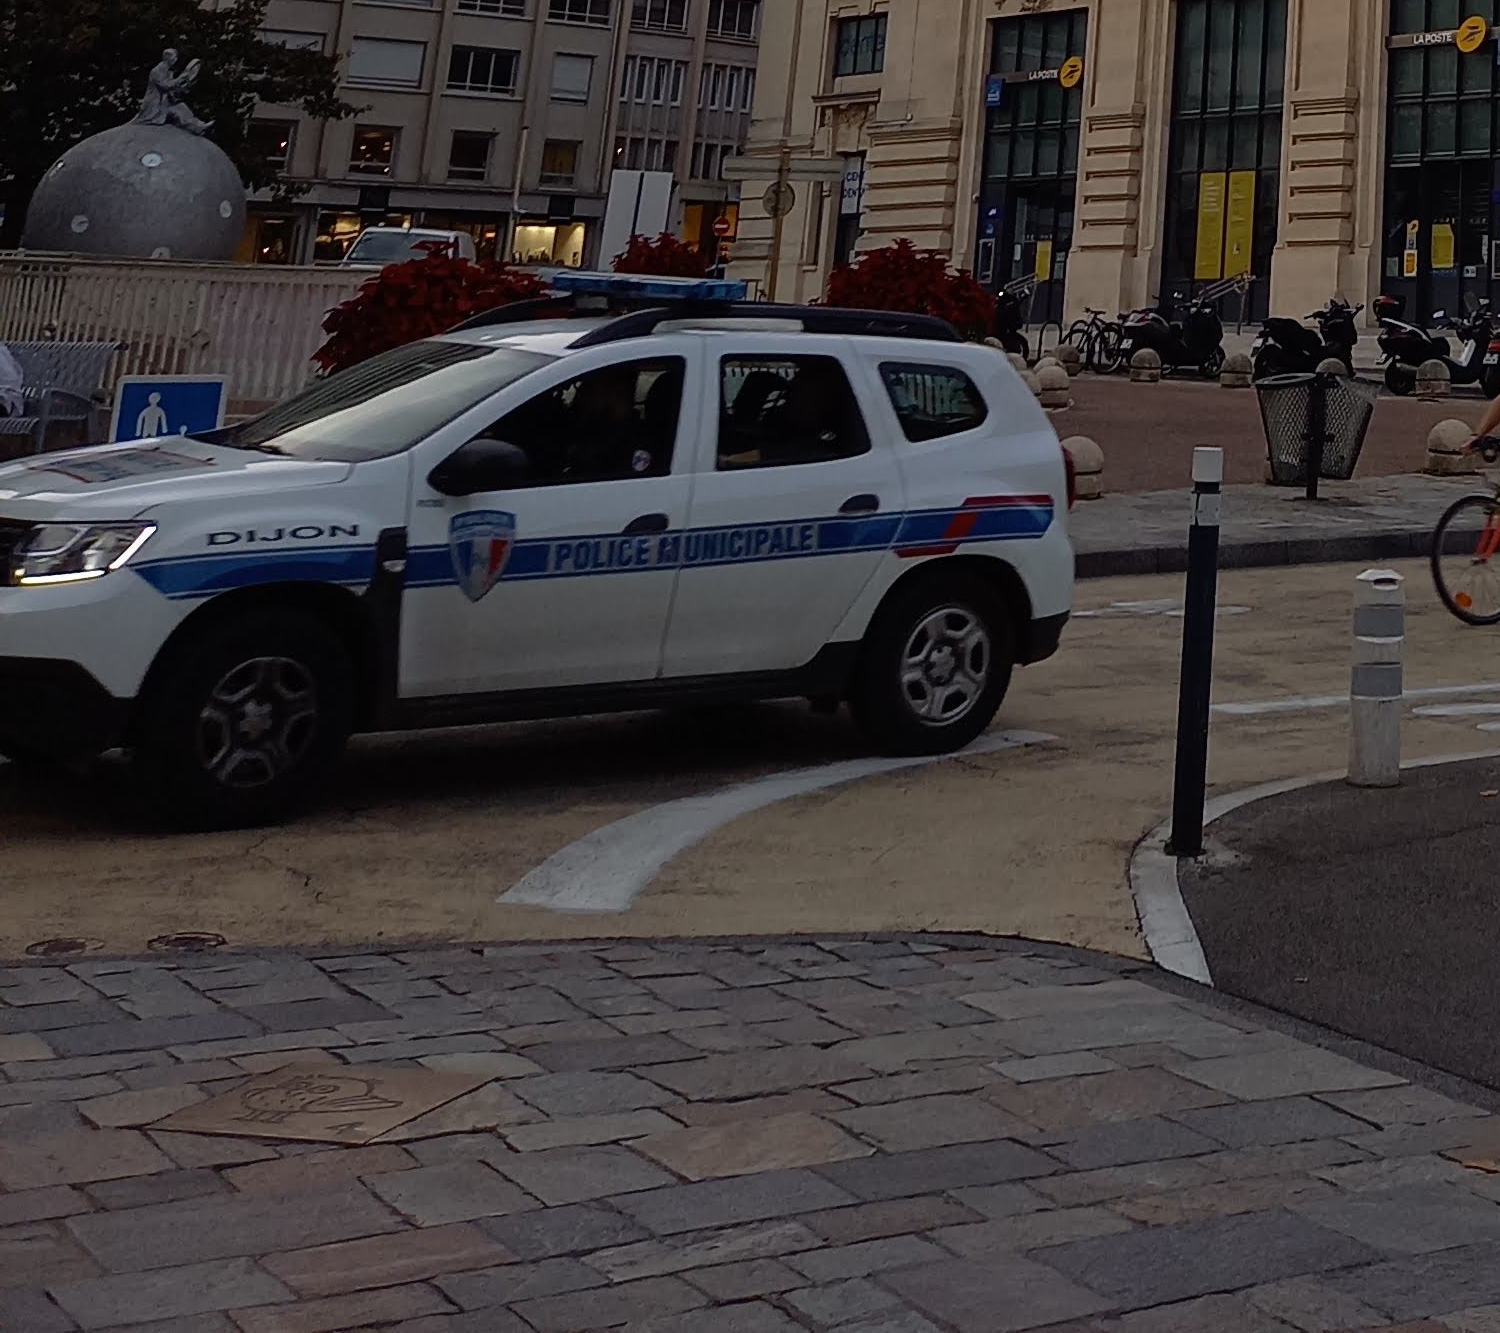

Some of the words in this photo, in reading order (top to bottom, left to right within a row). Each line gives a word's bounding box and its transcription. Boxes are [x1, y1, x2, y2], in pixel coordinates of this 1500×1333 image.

[1413, 35, 1425, 44] LA
[1425, 32, 1452, 43] POSTE
[206, 524, 360, 546] DIJON
[554, 538, 649, 571] POLICE
[656, 524, 815, 565] MUNICIPALE
